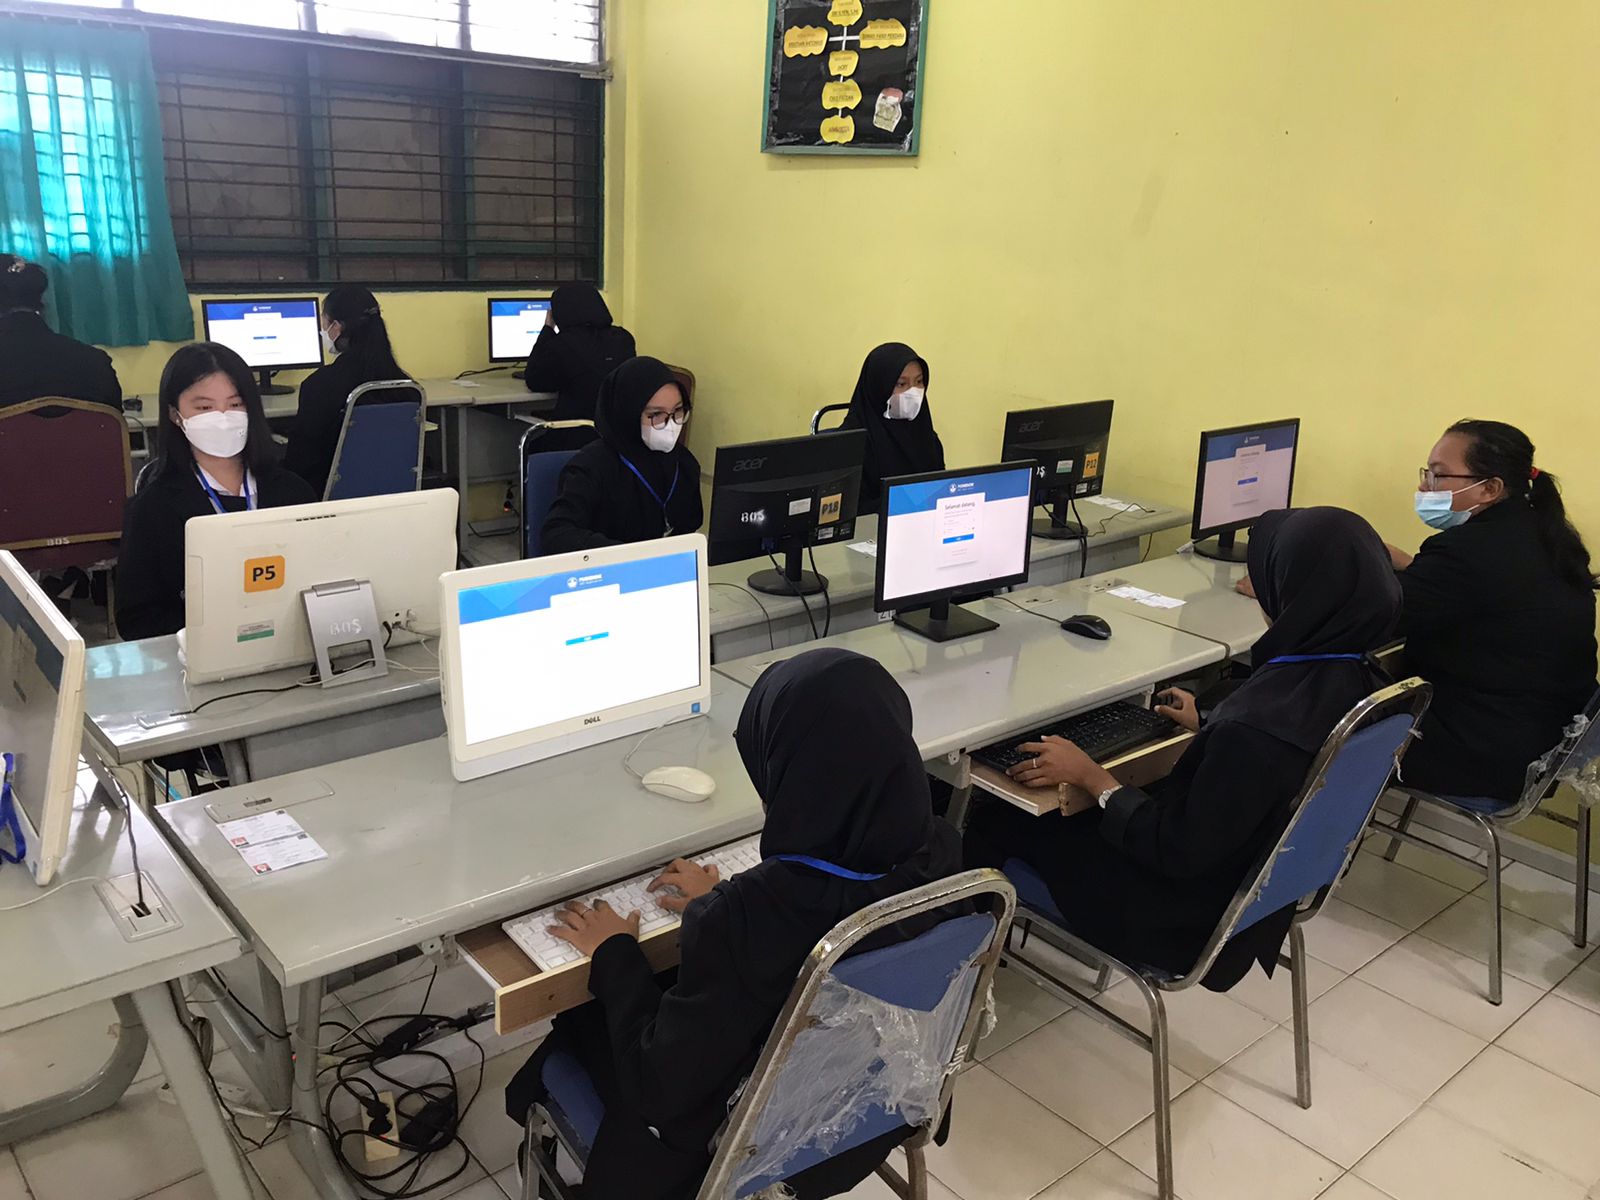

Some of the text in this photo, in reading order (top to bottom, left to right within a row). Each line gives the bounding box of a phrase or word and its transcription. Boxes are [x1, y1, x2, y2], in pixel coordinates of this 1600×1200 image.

[1018, 420, 1044, 433] acer
[732, 457, 767, 472] acer
[821, 501, 839, 515] P18
[741, 509, 765, 524] BOS
[252, 565, 276, 582] P5
[330, 618, 362, 635] BOS
[584, 716, 601, 725] DELL
